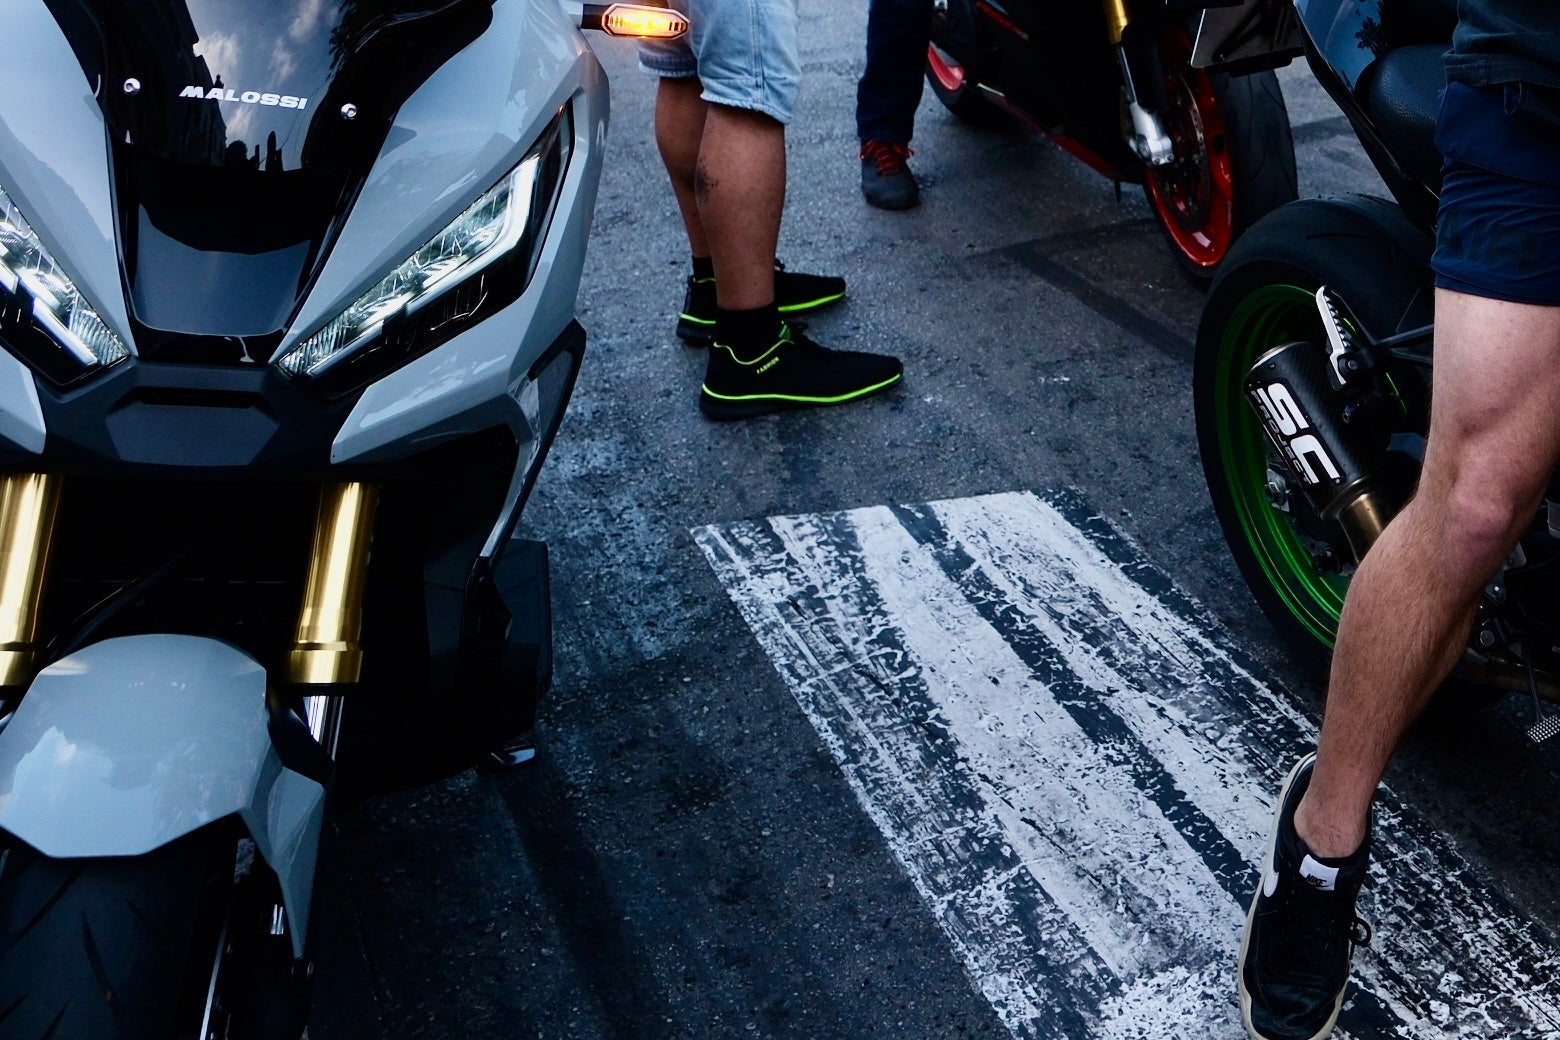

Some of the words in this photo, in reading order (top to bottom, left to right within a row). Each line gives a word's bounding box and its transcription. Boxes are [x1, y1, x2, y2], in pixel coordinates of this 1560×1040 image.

[178, 85, 308, 110] MALOSSI
[1250, 389, 1313, 486] PROJECT
[1256, 382, 1341, 485] SC
